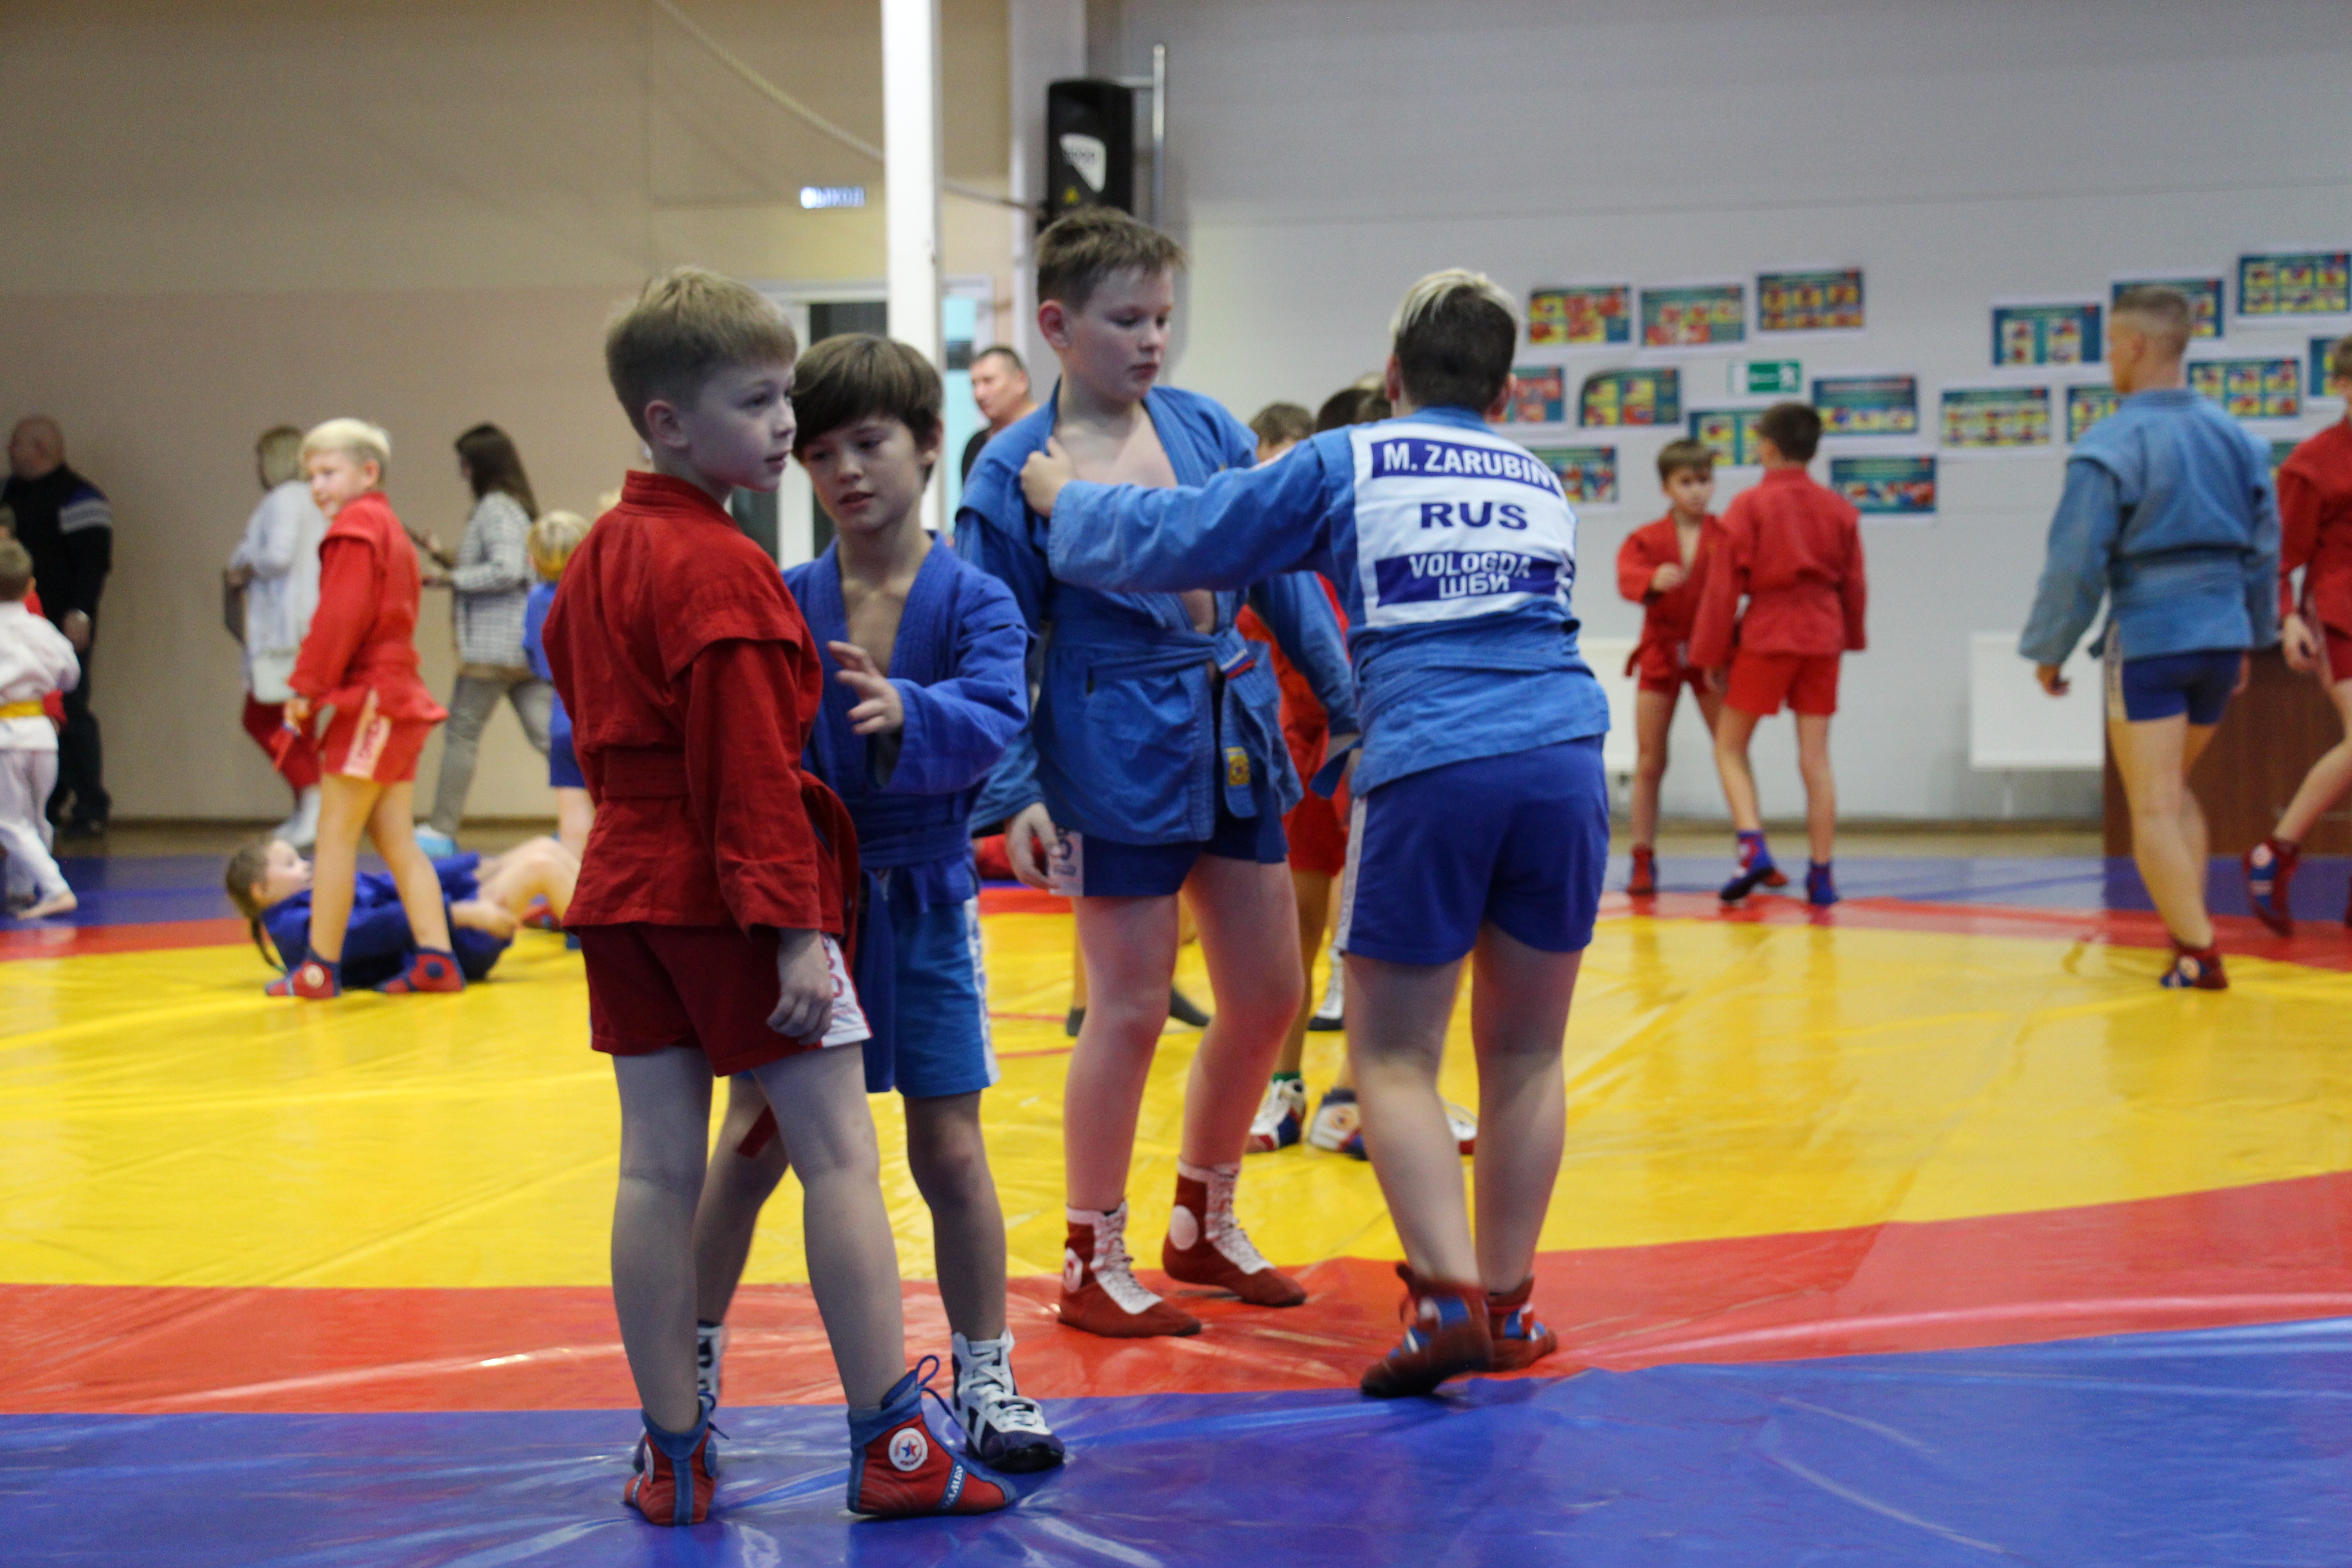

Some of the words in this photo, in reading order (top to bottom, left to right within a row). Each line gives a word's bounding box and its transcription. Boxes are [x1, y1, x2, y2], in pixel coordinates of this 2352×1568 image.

[1383, 442, 1418, 471] M.
[1421, 502, 1527, 530] RUS
[1409, 552, 1532, 578] VOLOGDA
[1438, 573, 1510, 599] ШБИ
